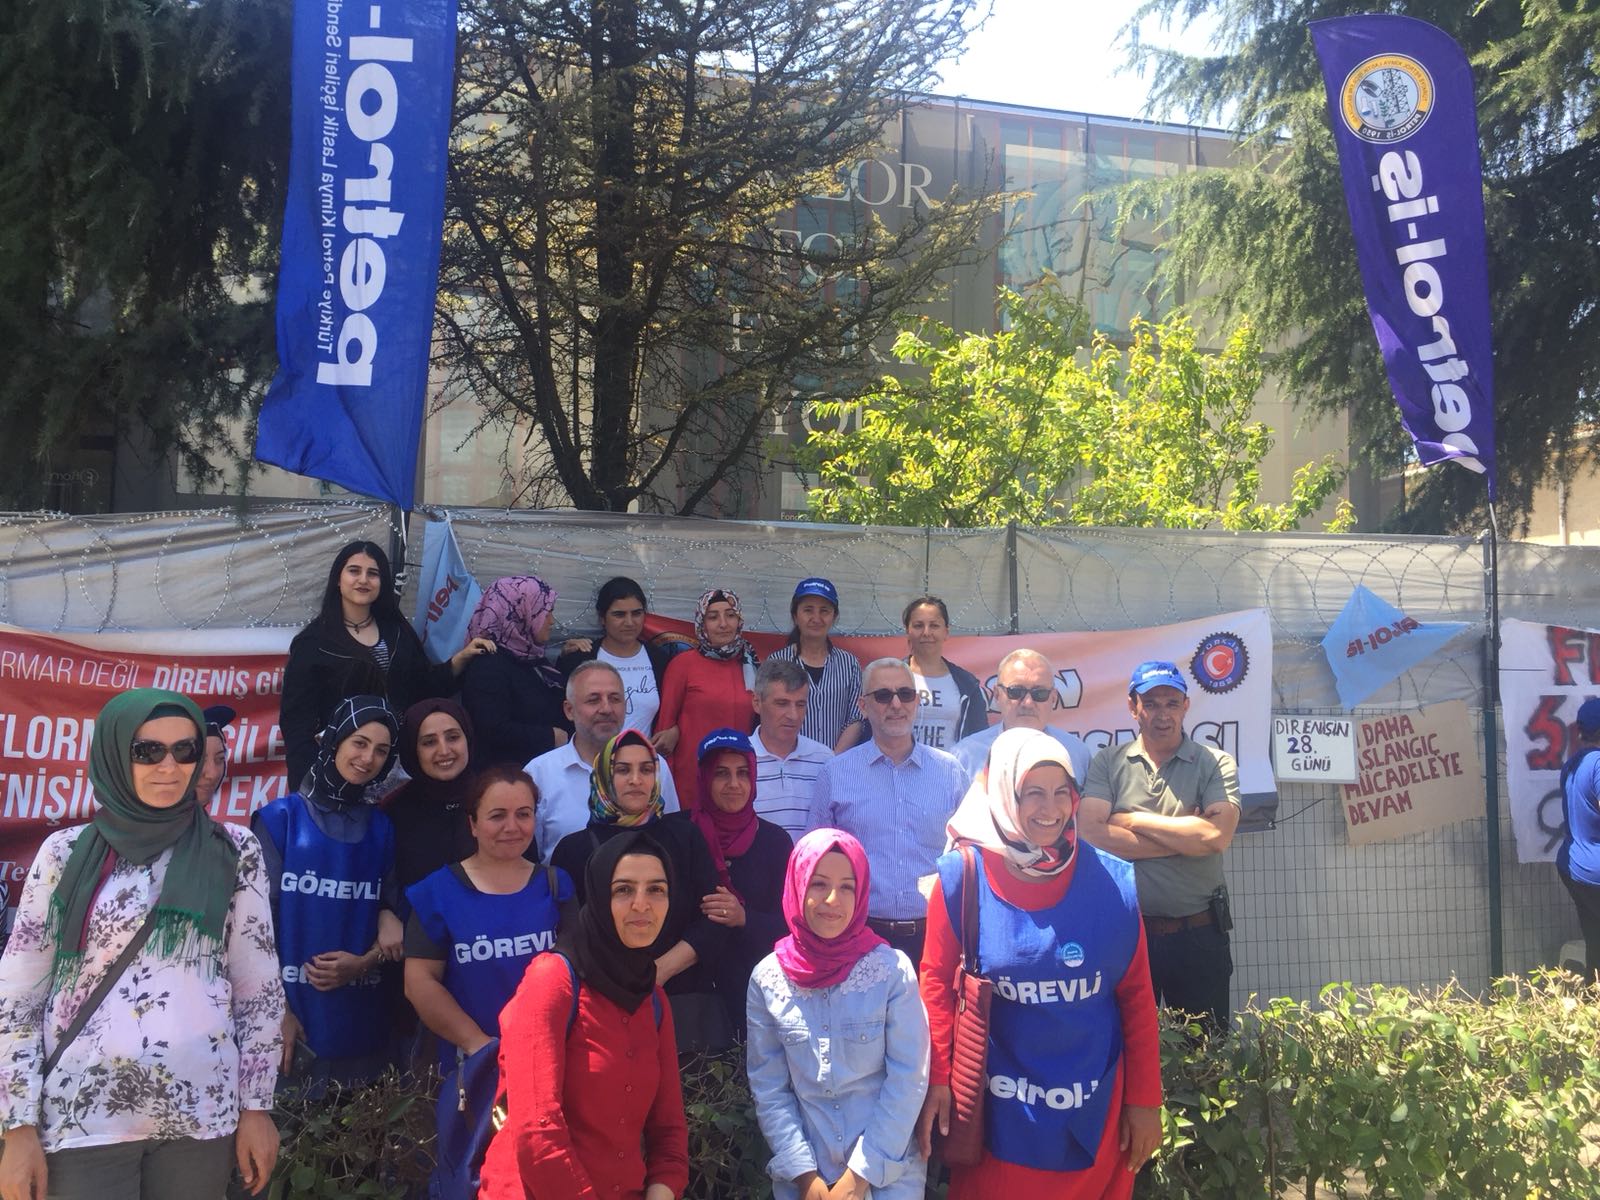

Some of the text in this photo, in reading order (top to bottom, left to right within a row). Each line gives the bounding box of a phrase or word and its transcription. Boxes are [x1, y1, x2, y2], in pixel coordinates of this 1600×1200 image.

[0, 650, 286, 700] RMAR DEĞİL DİRENİŞ GÜ
[1286, 734, 1318, 754] 28.
[1361, 714, 1415, 747] DAHA
[1290, 755, 1332, 772] GÜNÜ
[1348, 790, 1414, 826] DEVAM
[280, 869, 382, 901] GÖREVLİ
